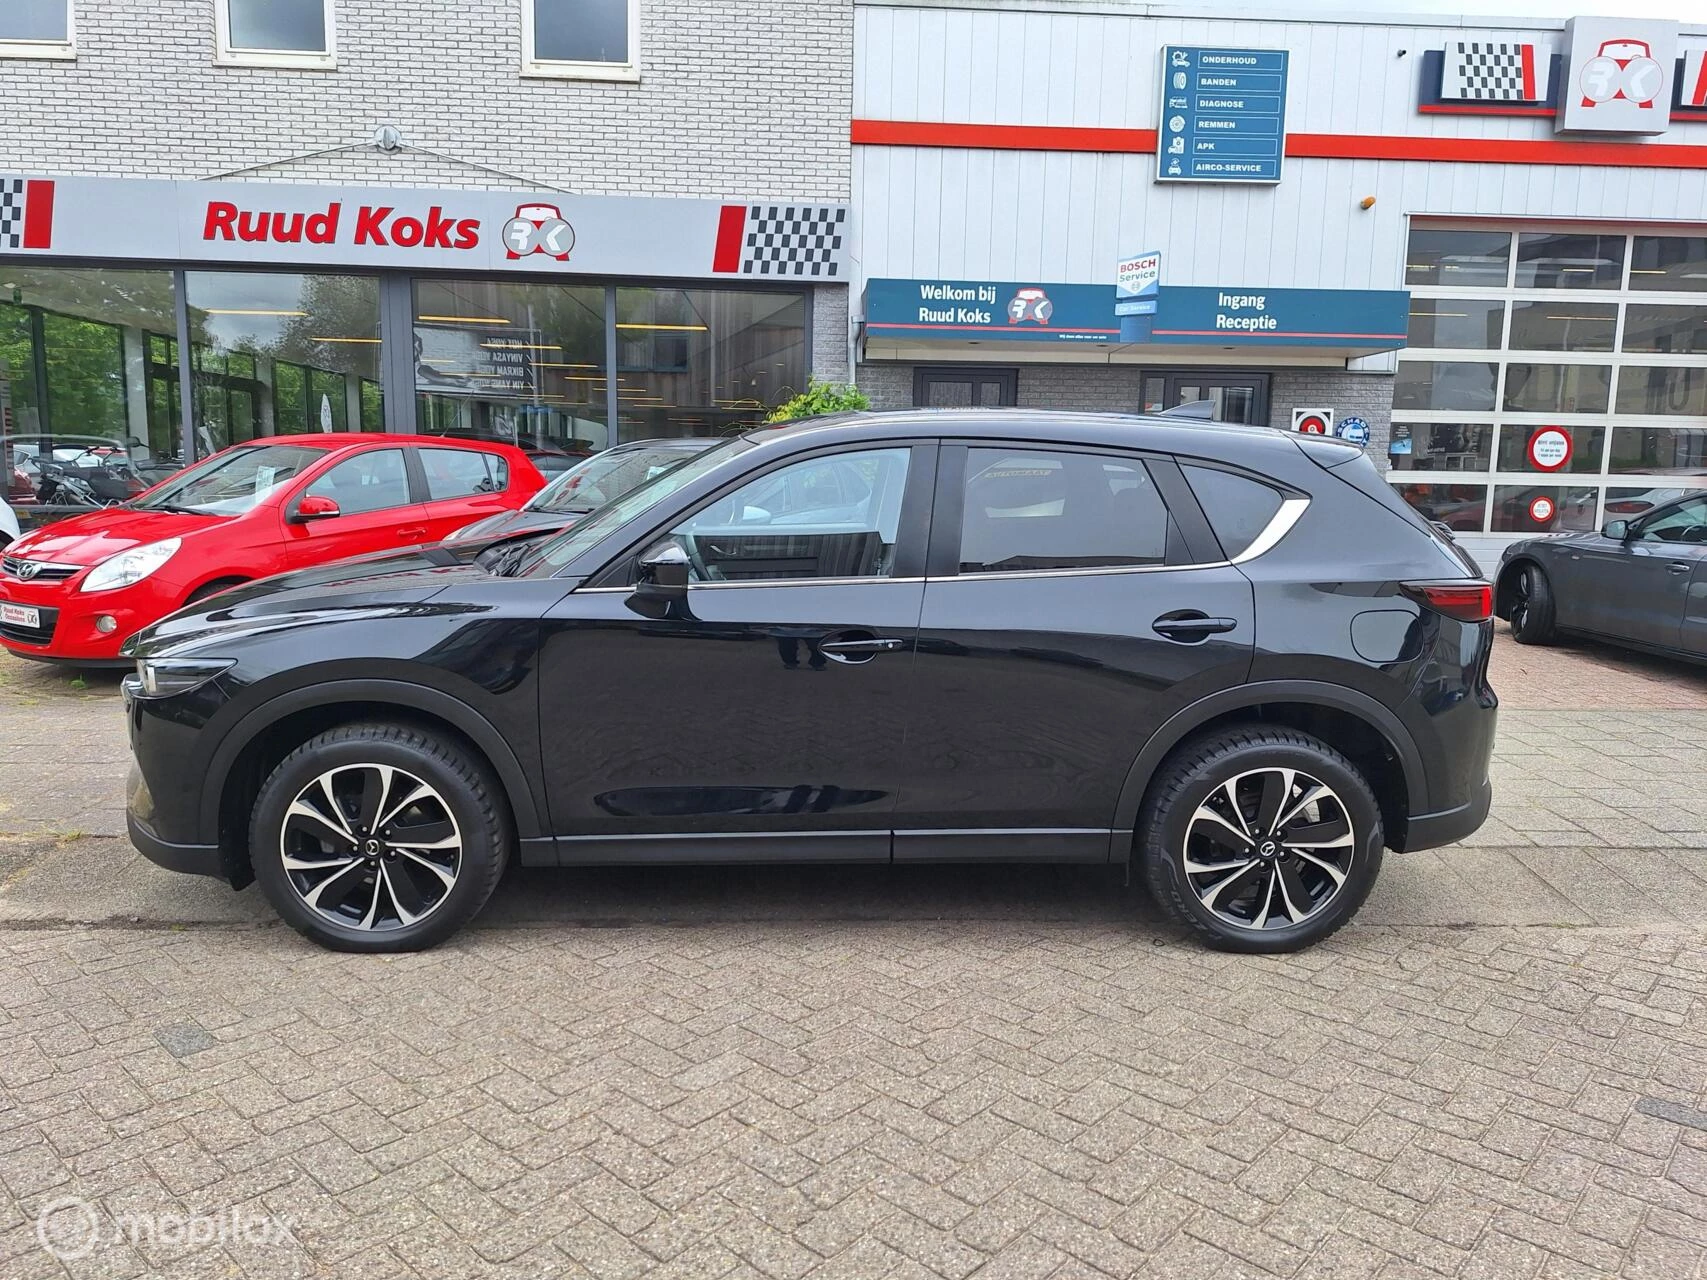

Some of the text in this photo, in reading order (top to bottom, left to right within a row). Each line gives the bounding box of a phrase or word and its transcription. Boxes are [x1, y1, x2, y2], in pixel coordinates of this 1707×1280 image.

[1202, 56, 1257, 65] ONDERHOUD
[1200, 78, 1237, 86] BANDEN
[1199, 100, 1244, 108] DIAGNOSE
[1198, 121, 1236, 129] REMMEN
[1195, 163, 1262, 172] AIRCO-SERVICE
[203, 201, 481, 249] Ruud Koks
[1120, 258, 1156, 273] BOSCH
[1119, 270, 1156, 282] Service
[920, 285, 996, 305] Welkom bij
[1218, 292, 1266, 310] Ingang
[919, 307, 991, 324] Ruud Koks
[1216, 314, 1277, 332] Receptie
